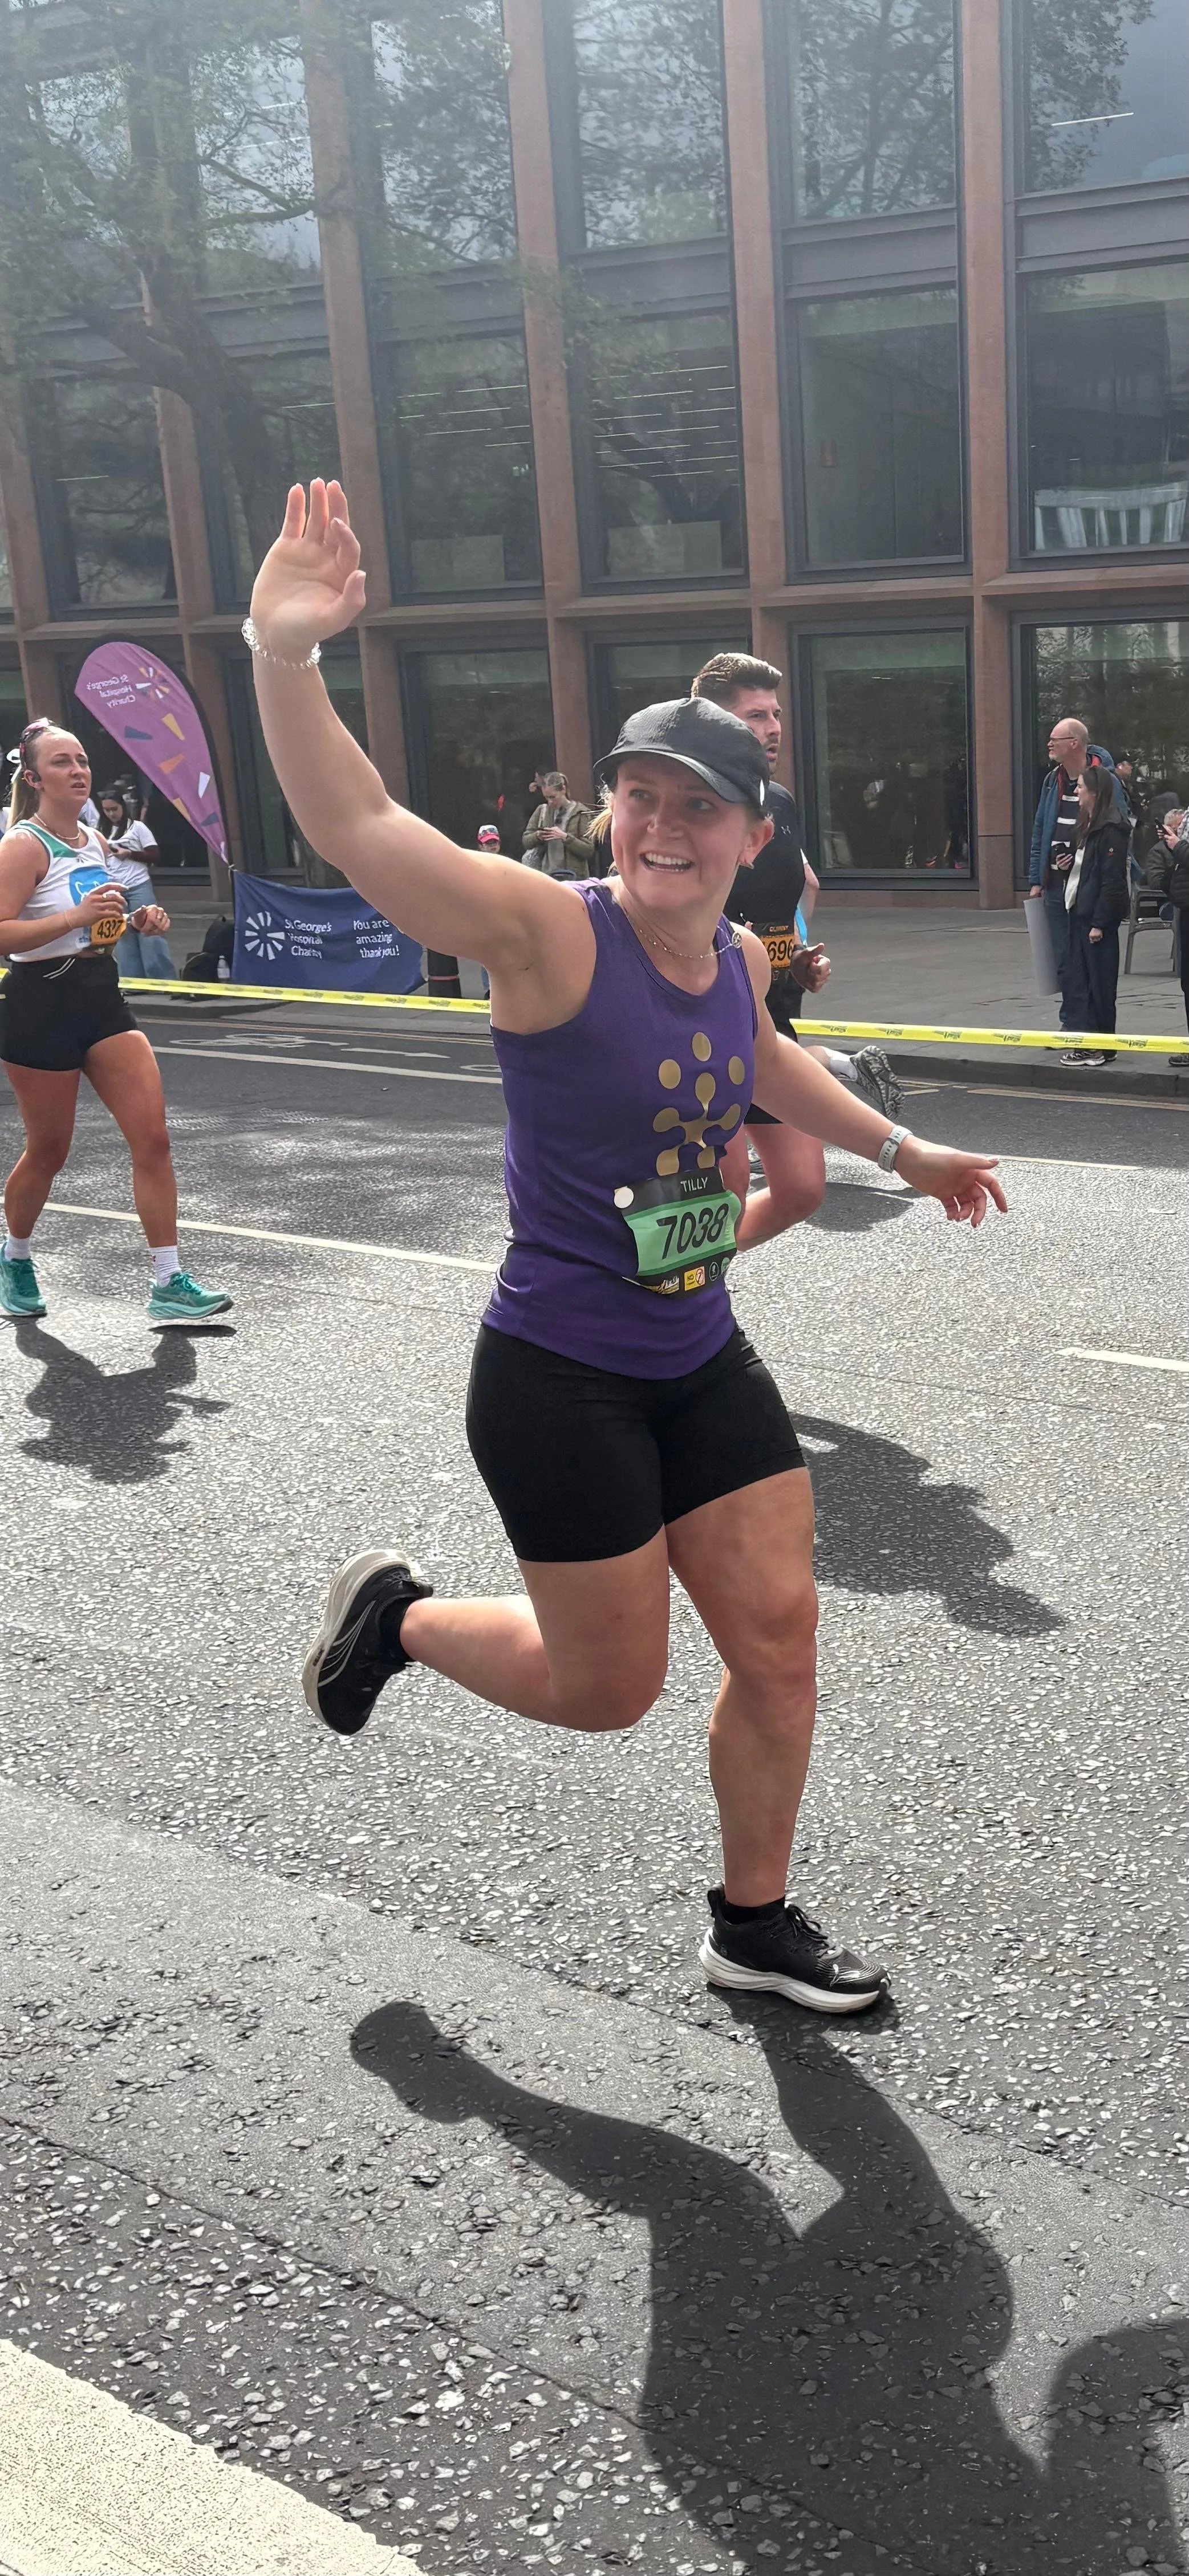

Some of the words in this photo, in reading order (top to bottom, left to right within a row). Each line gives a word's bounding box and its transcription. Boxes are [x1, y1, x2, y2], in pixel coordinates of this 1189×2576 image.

[294, 920, 332, 934] George's
[353, 920, 370, 930] You
[372, 919, 390, 929] are
[356, 931, 392, 944] amazing
[763, 939, 793, 962] 696
[680, 1177, 708, 1193] TILLY
[656, 1203, 729, 1260] 7038
